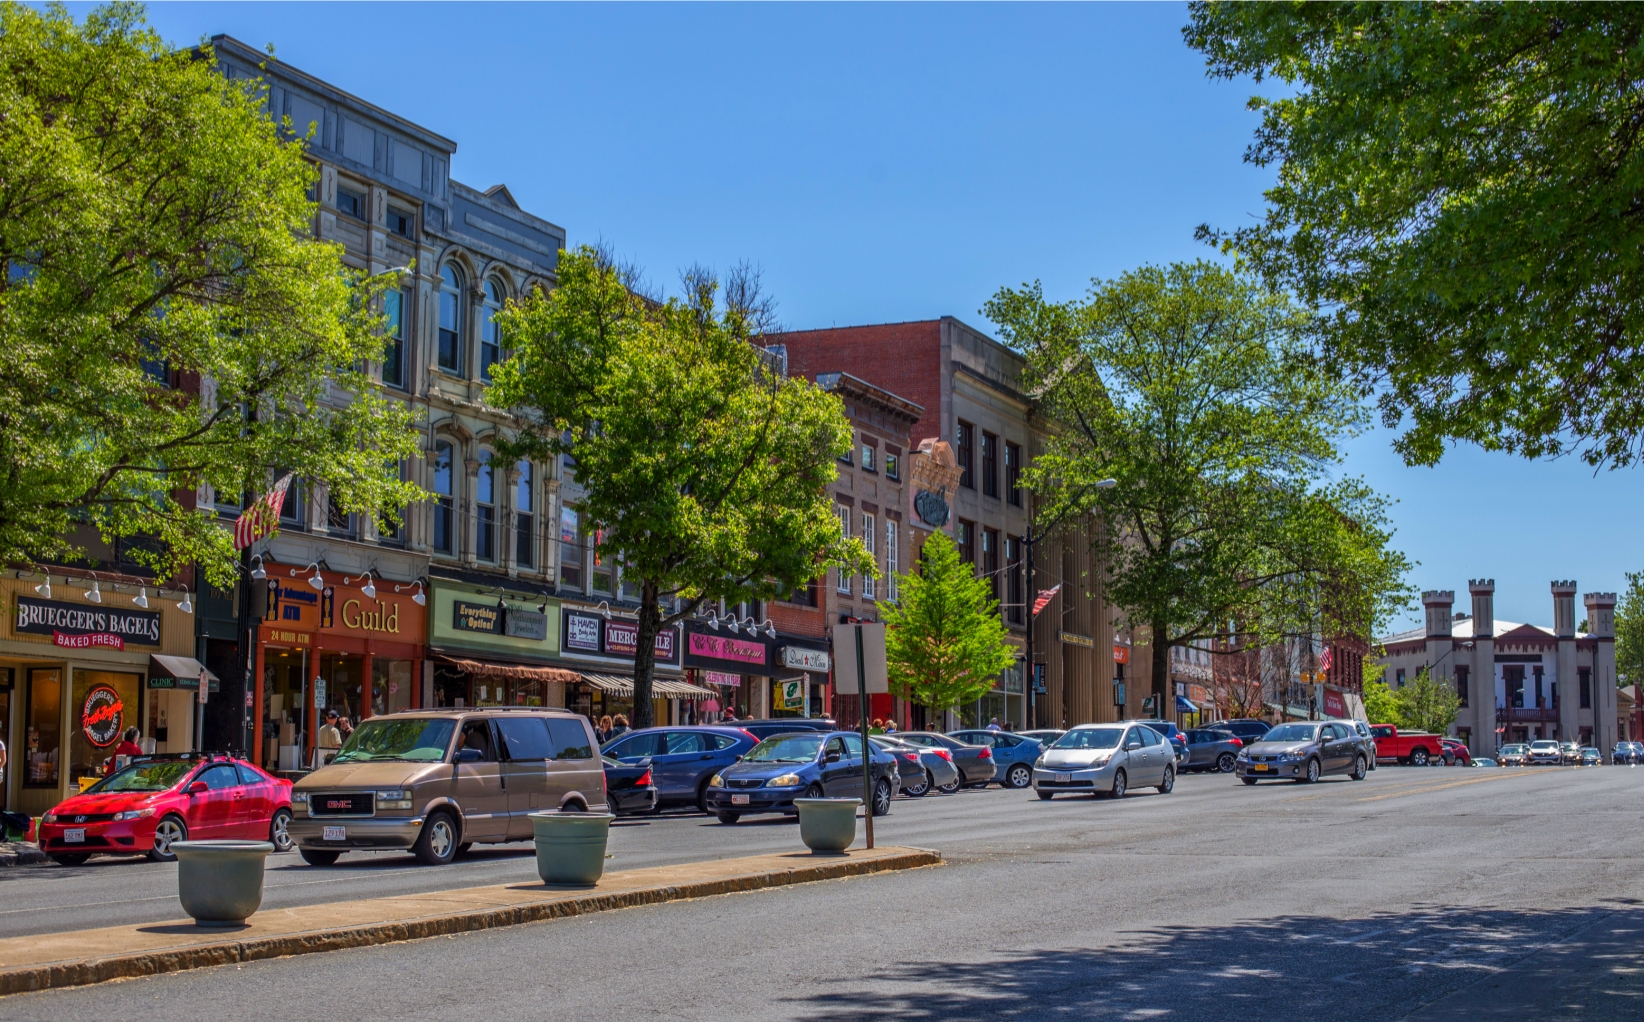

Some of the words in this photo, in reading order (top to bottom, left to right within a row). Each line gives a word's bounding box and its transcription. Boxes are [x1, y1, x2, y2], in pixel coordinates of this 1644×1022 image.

[342, 599, 400, 634] Guild
[460, 604, 497, 620] Everything
[17, 603, 106, 632] BRUEGGER'S
[109, 614, 159, 640] BAGELS
[468, 616, 494, 630] Optical
[514, 622, 534, 634] Jewelers
[578, 618, 598, 630] HAVEN
[58, 634, 89, 646] BAKED
[92, 634, 121, 648] FRESH
[271, 630, 279, 640] 24
[280, 632, 296, 642] HOUR
[298, 634, 310, 644] ATM
[608, 630, 670, 650] MERCILE
[88, 725, 104, 742] BAGEL
[104, 713, 118, 741] BAKERY
[327, 800, 352, 808] GMC
